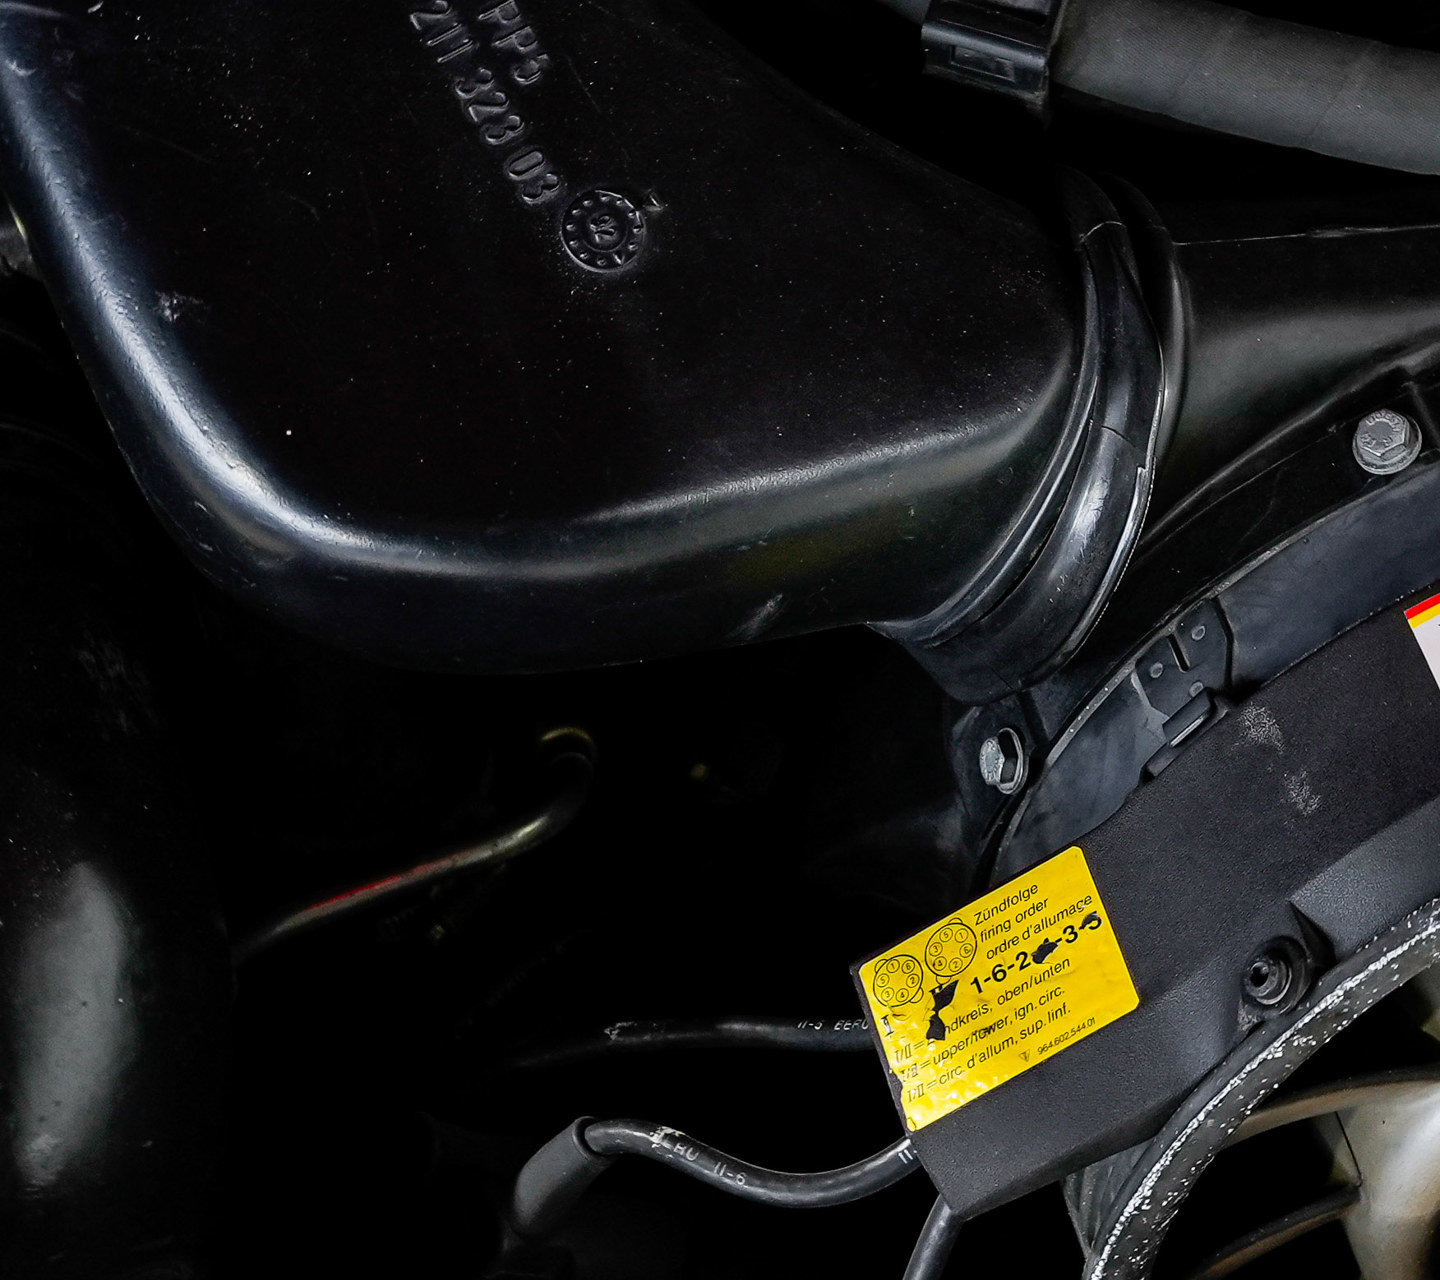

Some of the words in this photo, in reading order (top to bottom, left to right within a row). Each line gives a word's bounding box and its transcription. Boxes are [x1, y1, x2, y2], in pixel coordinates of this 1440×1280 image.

[455, 67, 526, 146] 323
[508, 149, 561, 206] 03
[973, 883, 1039, 927] Zündfolge
[979, 919, 1012, 944] firing
[1014, 897, 1049, 923] order
[986, 934, 1021, 960] ordre
[1022, 894, 1093, 940] d'allumage
[997, 957, 1070, 1007] oben/unten
[1038, 987, 1065, 1007] circ.
[939, 1065, 965, 1086] circ.
[967, 1035, 1019, 1069] d'allum,
[1020, 1019, 1047, 1040] sup.
